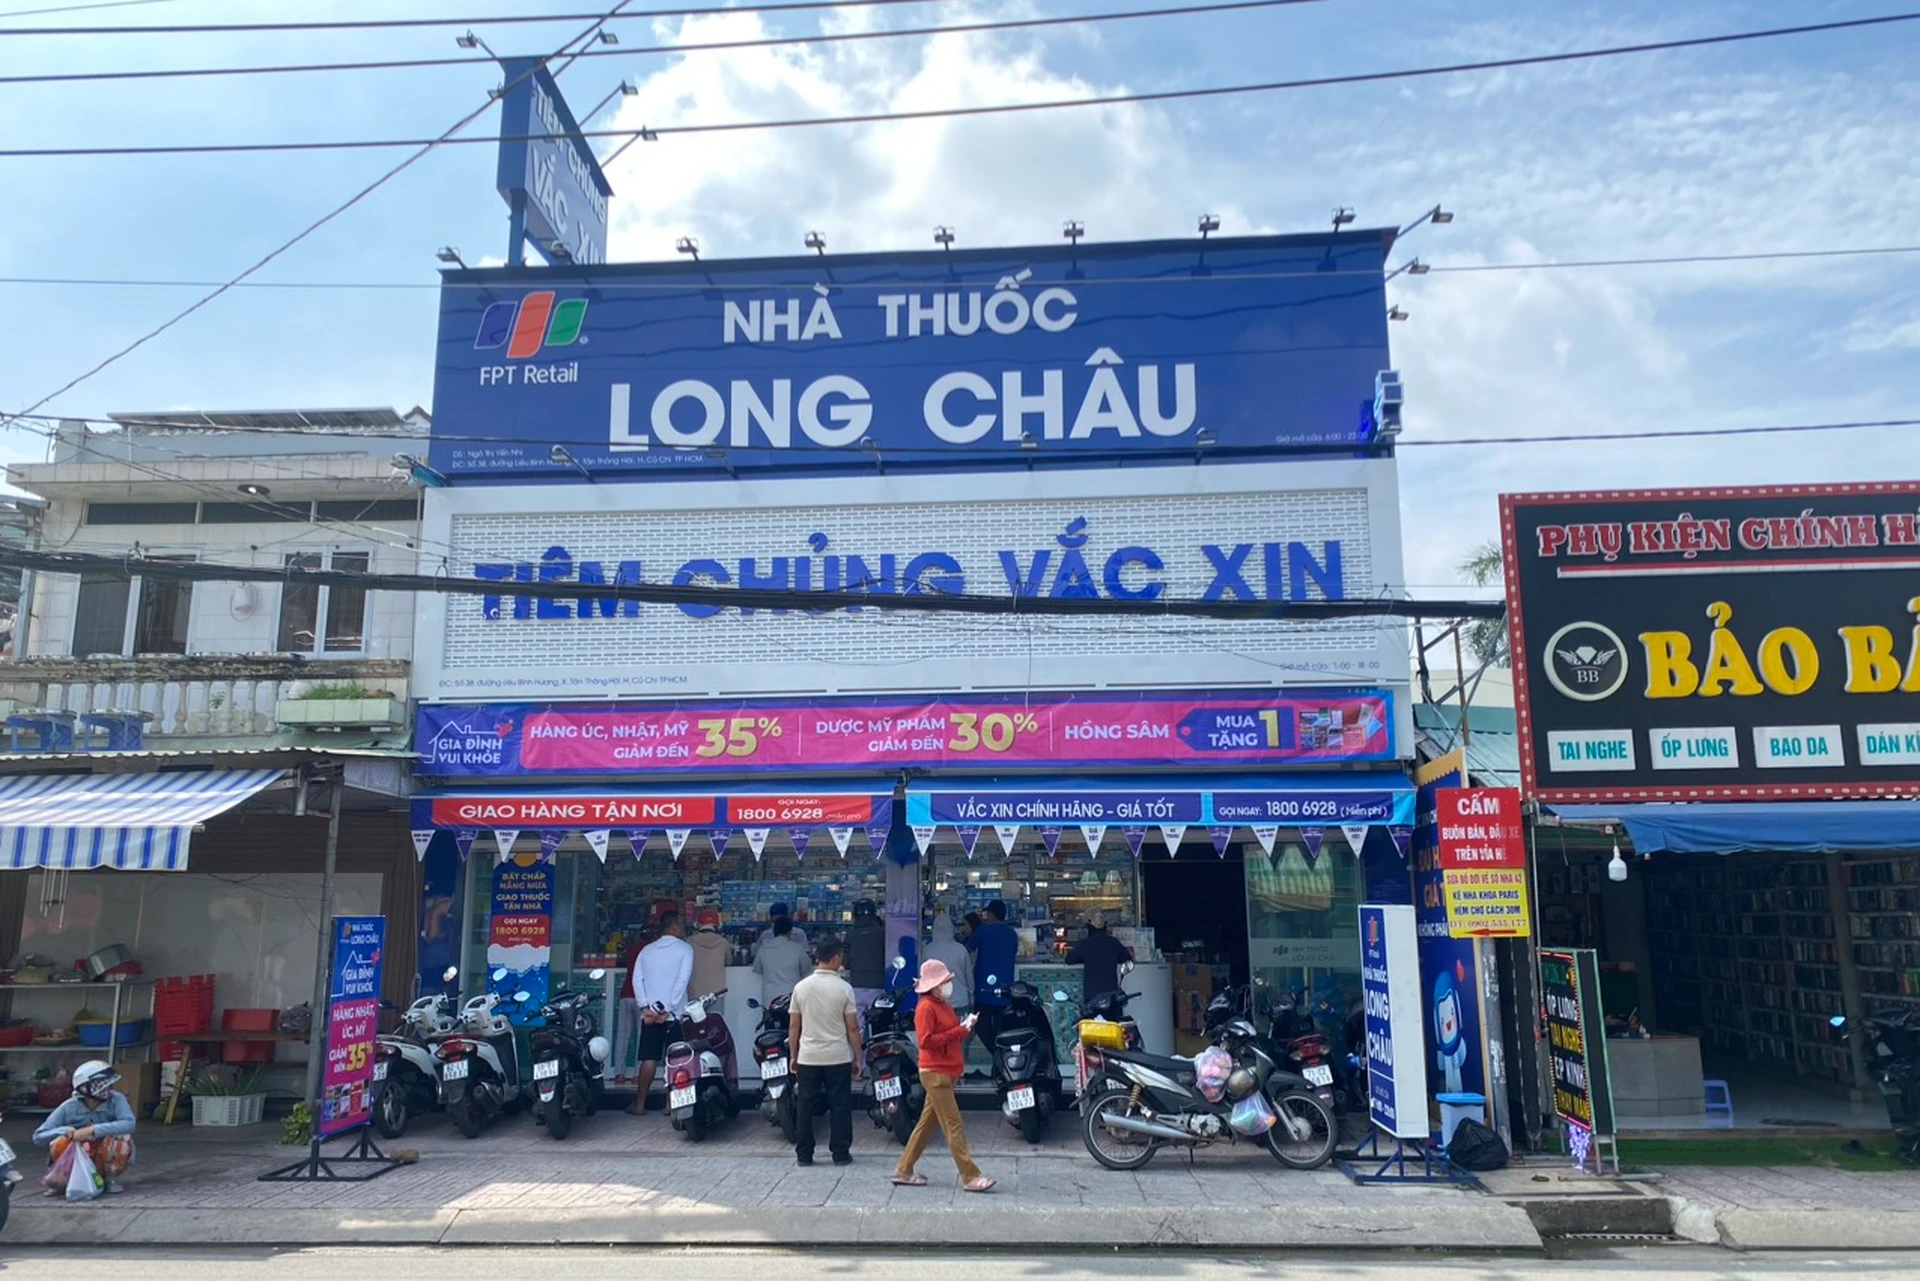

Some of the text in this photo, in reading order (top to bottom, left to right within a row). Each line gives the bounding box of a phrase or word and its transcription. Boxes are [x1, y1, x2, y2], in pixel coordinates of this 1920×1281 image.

[723, 268, 1078, 343] NHÀ THUỐC
[480, 362, 578, 386] FPT Retail
[608, 347, 1198, 453] LONG CHÂU
[1538, 523, 1622, 561] PHỤ
[1628, 513, 1731, 559] KIỆN
[1738, 508, 1879, 549] CHÍNH
[475, 516, 1343, 620] TIÊM CHỦNG VẮC XIN
[1638, 601, 1820, 698] BẢO
[1576, 669, 1600, 683] BB
[530, 719, 690, 742] HÀNG ÚC, NHẬT, MỸ
[816, 711, 945, 738] DƯỢC MỸ PHẨM
[949, 712, 1039, 752] 30%
[1064, 718, 1169, 740] HỒNG SÂM
[1216, 710, 1280, 747] MUA 1
[438, 734, 502, 751] GIA ĐÌNH
[696, 717, 783, 757] 35%
[868, 734, 943, 752] GIẢM ĐẾN
[1208, 731, 1258, 750] TẶNG
[1661, 732, 1729, 757] ỐP LƯNG
[1770, 737, 1828, 756] BAO DA
[1866, 731, 1900, 754] DÁN
[438, 748, 502, 765] VUI KHỎE
[613, 742, 690, 759] GIẢM ĐẾN
[1558, 739, 1628, 760] TAI NGHE
[459, 799, 682, 823] GIAO HÀNG TẬN NƠI
[737, 808, 775, 819] 1800
[781, 808, 823, 819] 6928
[957, 796, 986, 818] VẮC
[990, 802, 1014, 817] XIN
[1016, 797, 1057, 817] CHÍNH
[1060, 799, 1103, 817] HÃNG
[1117, 799, 1141, 816] GIÁ
[1145, 796, 1174, 816] TỐT
[1219, 806, 1236, 818] GỌI
[1238, 806, 1262, 816] NGAY:
[1266, 802, 1299, 815] 1800
[1302, 801, 1337, 815] 6928
[1457, 791, 1500, 816] CẤM
[1442, 824, 1465, 840] BUÔN
[1467, 823, 1488, 841] BÁN,
[1508, 826, 1520, 838] XE
[1455, 845, 1478, 861] TRÊN
[1479, 890, 1497, 899] KHOA
[1499, 890, 1519, 899] PARIS
[333, 1005, 354, 1021] HÀNG
[1365, 989, 1389, 1021] LONG
[1368, 1027, 1393, 1067] CHÂU
